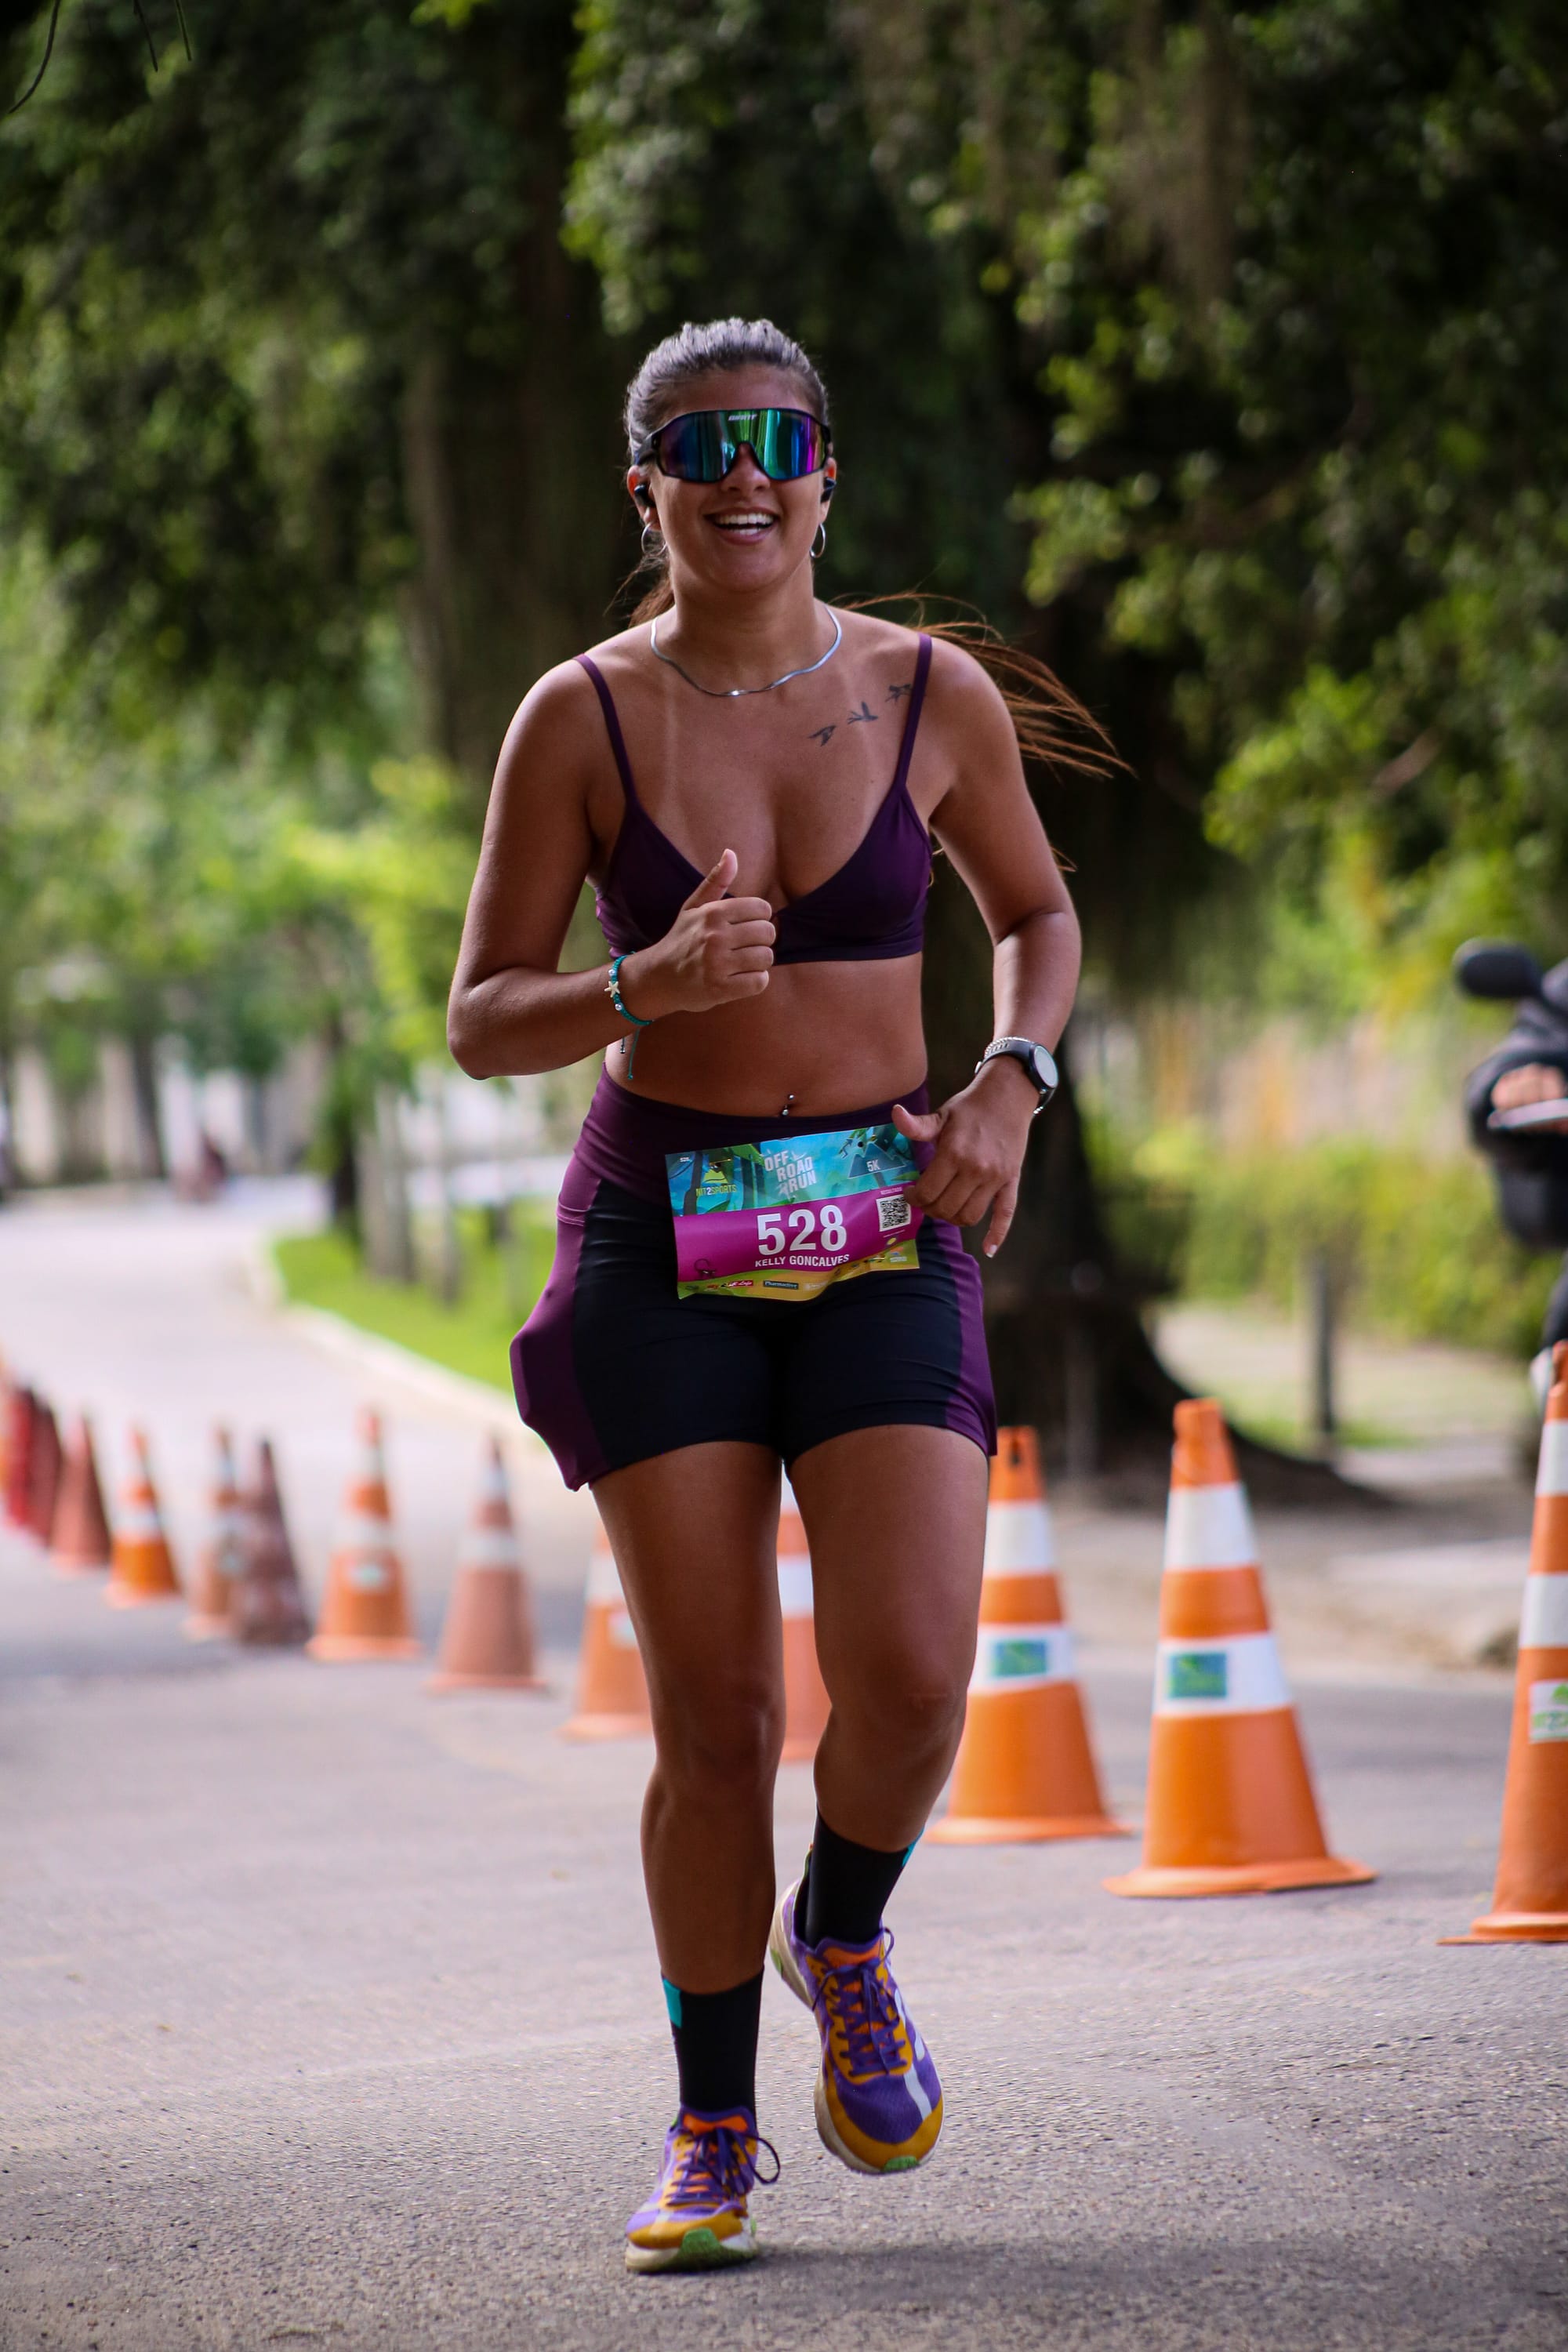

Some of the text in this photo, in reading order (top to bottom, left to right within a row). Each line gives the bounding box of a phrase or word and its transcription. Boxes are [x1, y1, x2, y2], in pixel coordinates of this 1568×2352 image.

[764, 1150, 789, 1171] OFF
[777, 1156, 813, 1182] ROAD
[866, 1160, 880, 1172] 5K
[788, 1170, 817, 1193] RUN
[757, 1204, 847, 1256] 528
[755, 1254, 850, 1268] KELLY GONCALVES
